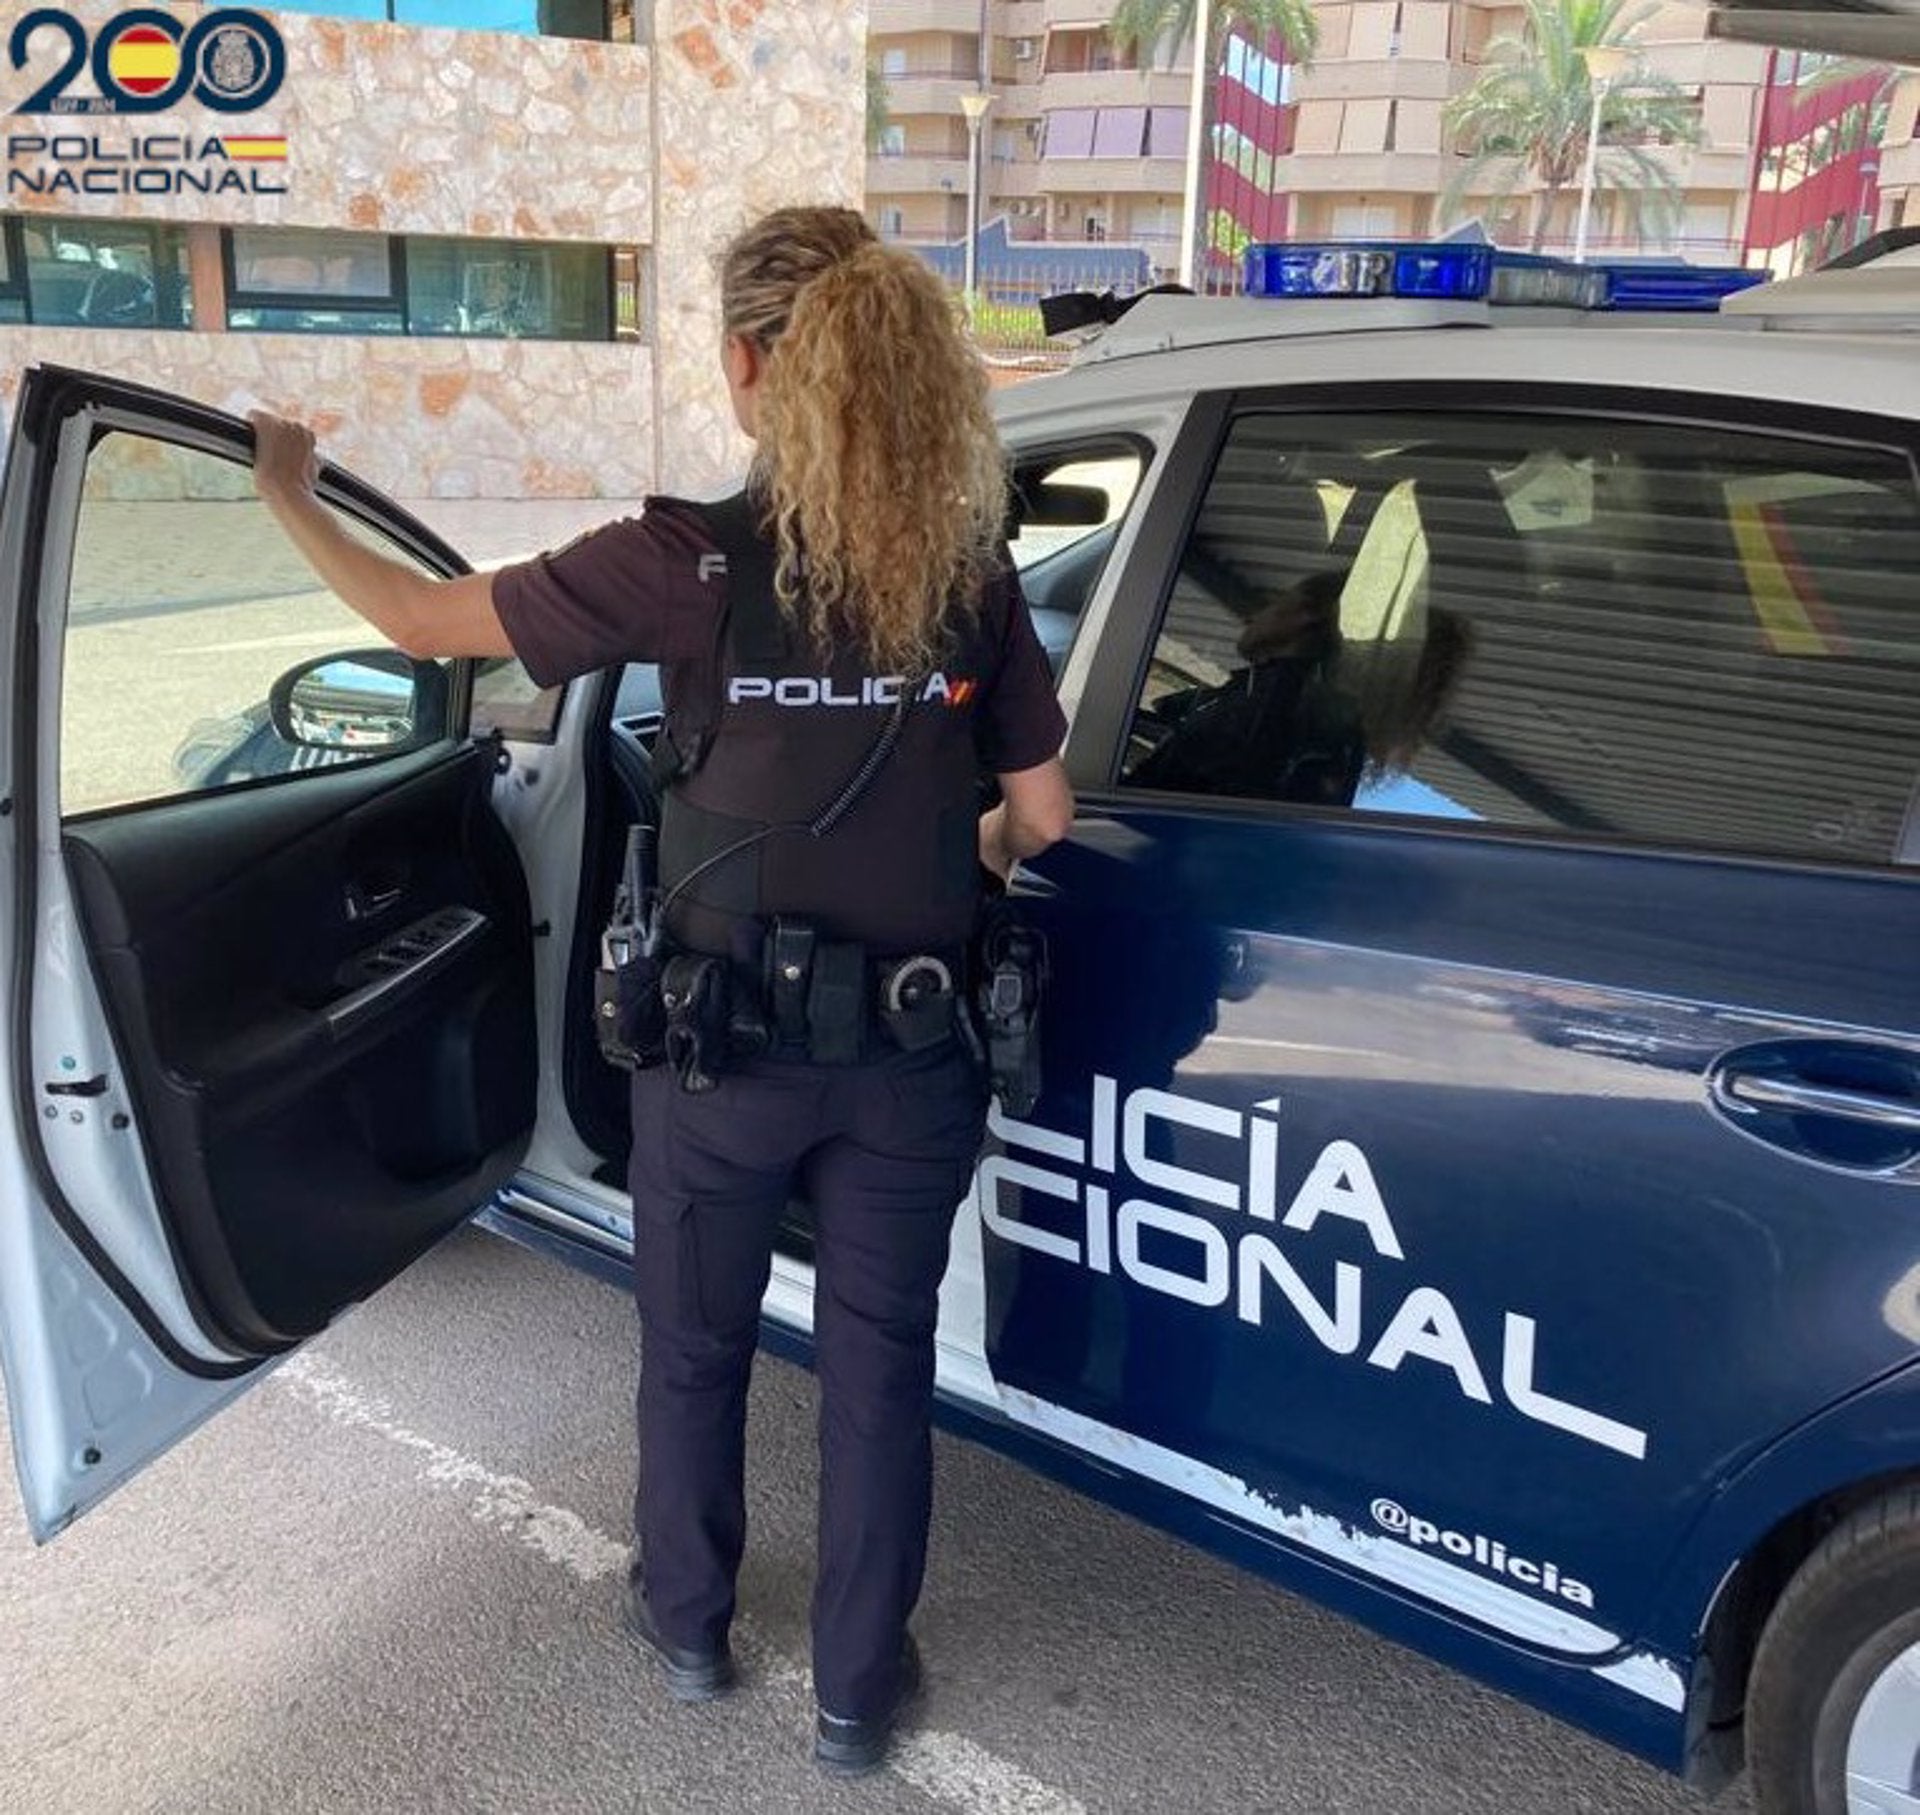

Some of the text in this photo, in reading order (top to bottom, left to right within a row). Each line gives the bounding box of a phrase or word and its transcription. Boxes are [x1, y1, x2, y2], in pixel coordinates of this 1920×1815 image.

[729, 672, 951, 706] POLICA
[980, 1155, 1647, 1460] CIONAL
[1370, 1498, 1594, 1608] @policia
